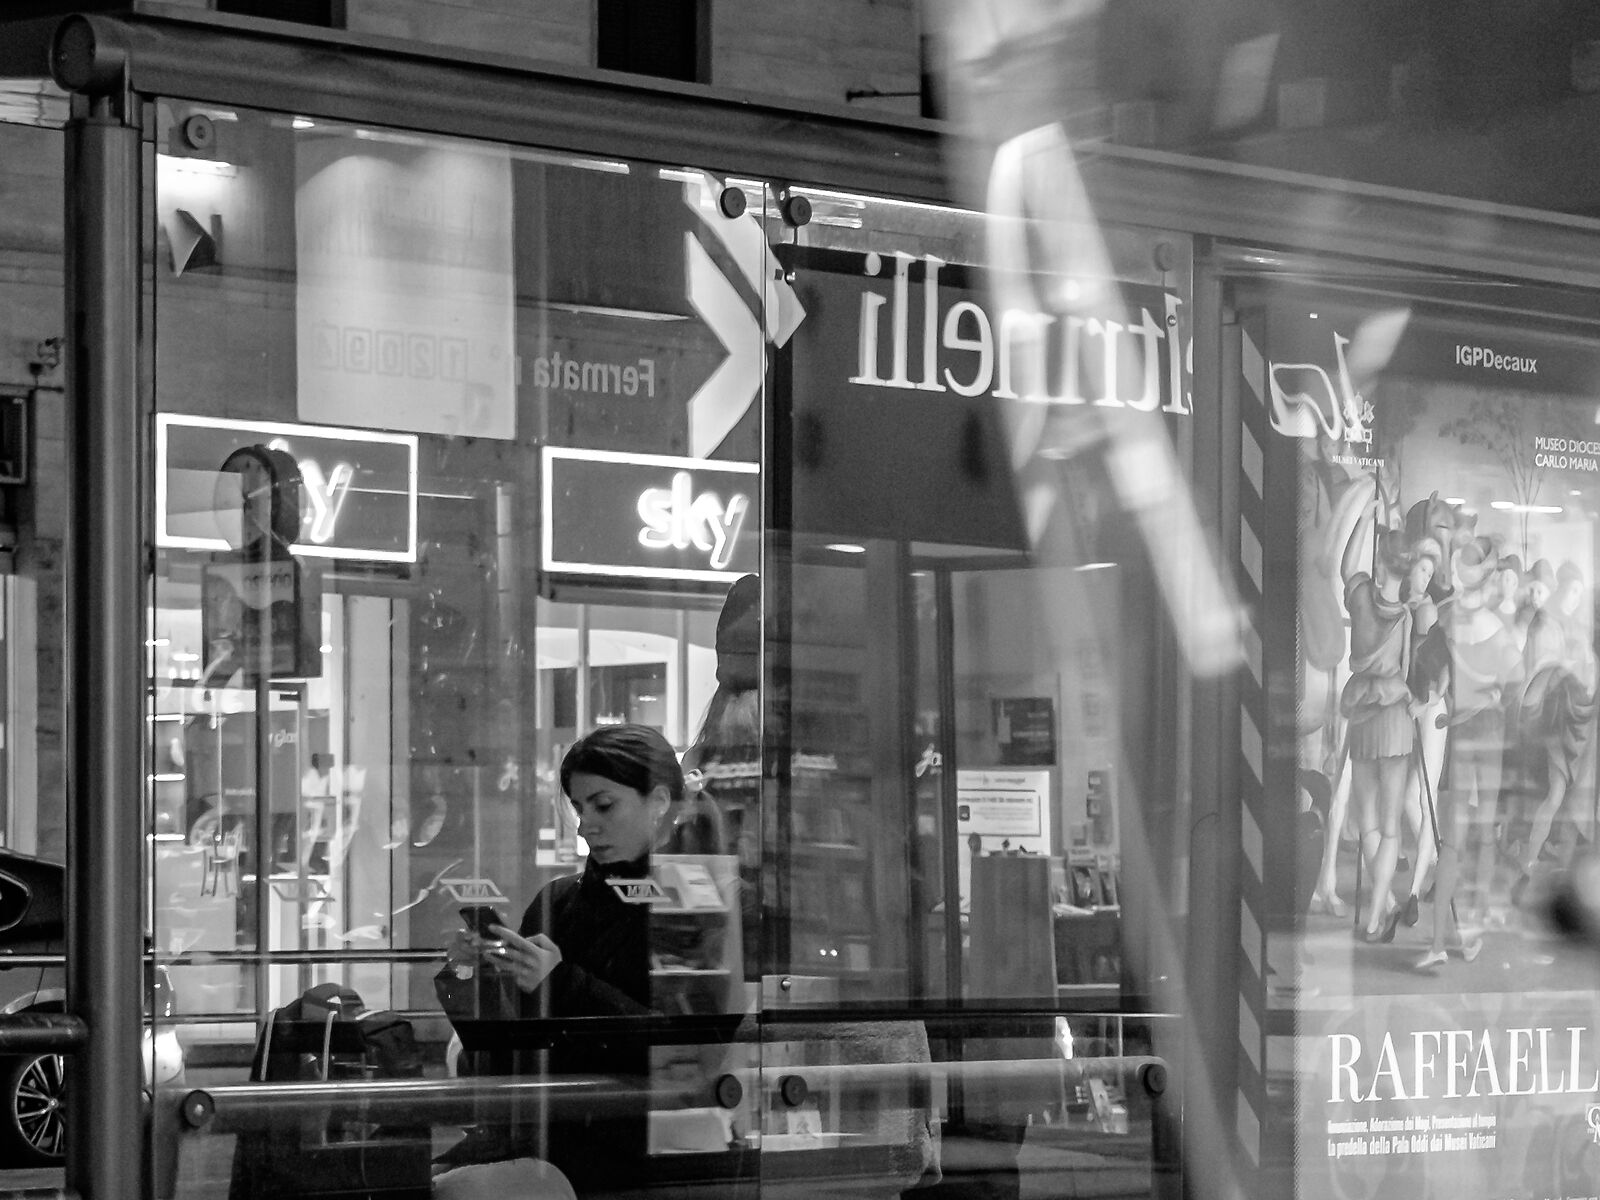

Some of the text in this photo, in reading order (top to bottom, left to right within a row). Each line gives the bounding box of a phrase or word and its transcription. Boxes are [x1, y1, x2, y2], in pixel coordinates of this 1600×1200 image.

[1456, 345, 1538, 373] IGPDecaux
[1535, 436, 1567, 451] MUSEO
[1535, 453, 1598, 472] CARLO MARIA
[638, 471, 749, 570] sky
[1327, 1027, 1599, 1103] RAFFAELL
